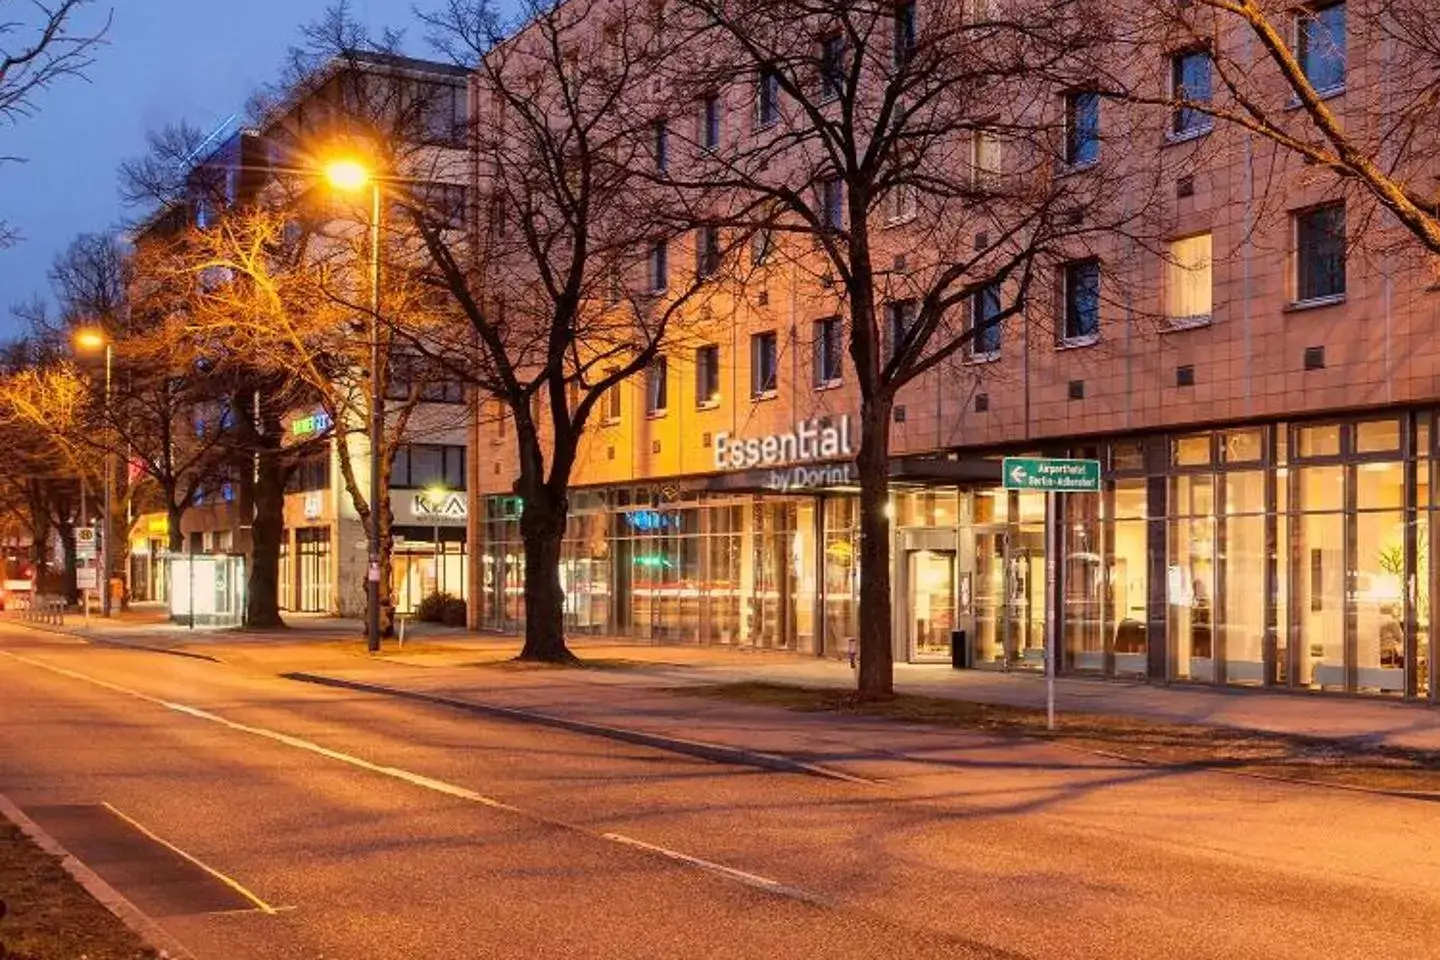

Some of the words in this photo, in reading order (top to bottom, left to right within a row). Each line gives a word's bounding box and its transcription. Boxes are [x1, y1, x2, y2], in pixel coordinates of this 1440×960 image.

[715, 413, 851, 469] Essential
[770, 469, 790, 492] by
[794, 464, 850, 488] Dorint
